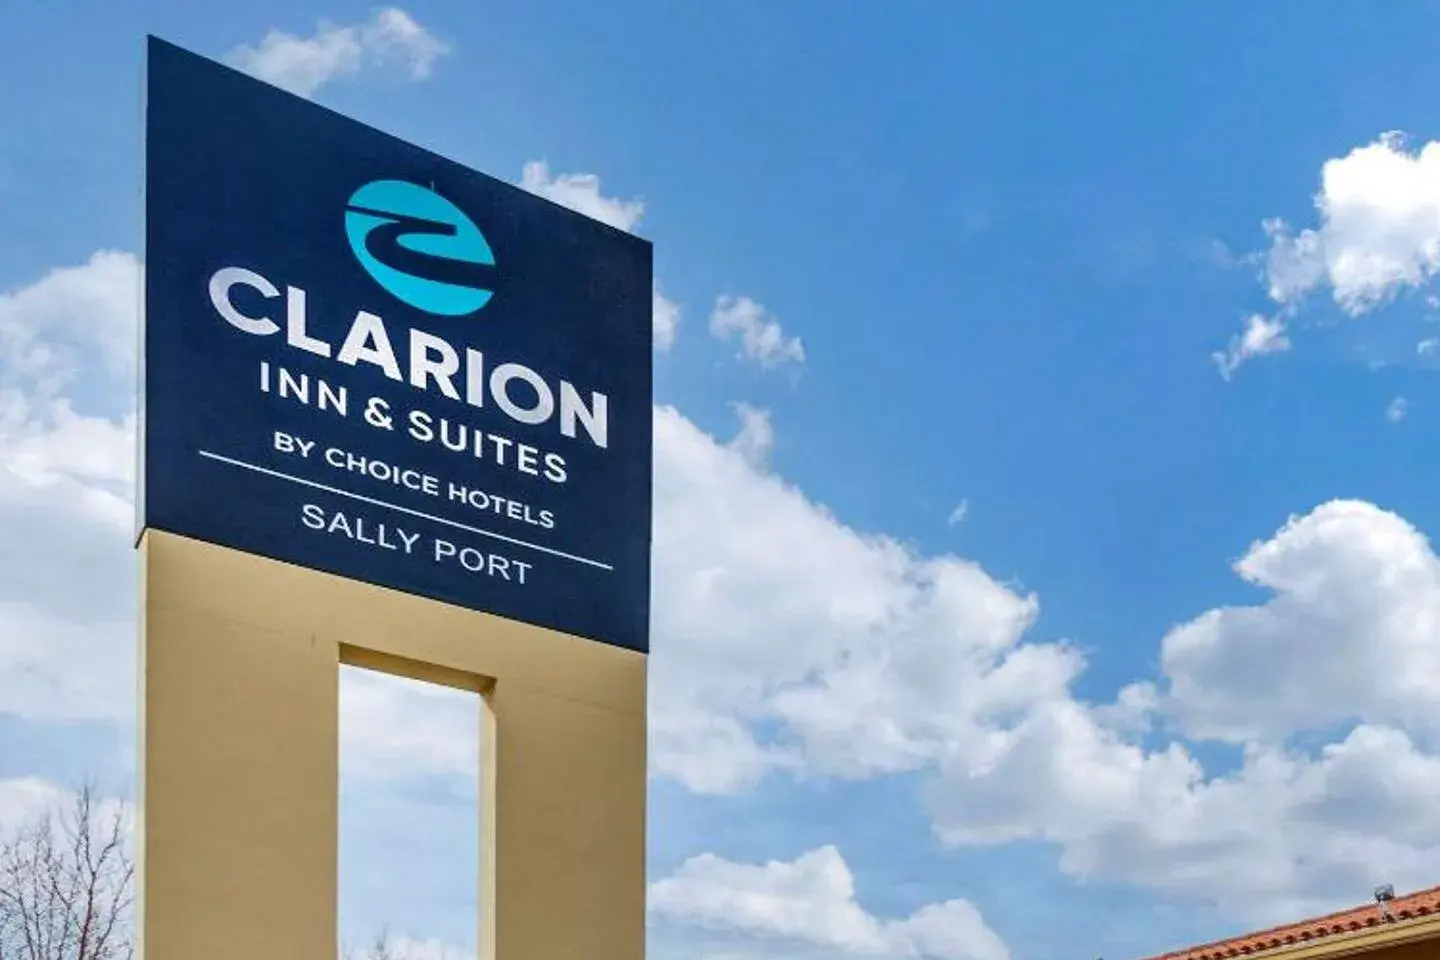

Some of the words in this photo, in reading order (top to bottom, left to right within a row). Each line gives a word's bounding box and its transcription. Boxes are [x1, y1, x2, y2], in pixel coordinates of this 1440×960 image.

[208, 267, 608, 449] CLARION
[260, 361, 347, 417] INN
[363, 396, 394, 431] &
[408, 410, 567, 483] SUITES
[274, 431, 316, 458] BY
[325, 447, 439, 497] CHOICE
[448, 482, 555, 530] HOTELS
[301, 504, 420, 554] SALLY
[435, 538, 532, 585] PORT
